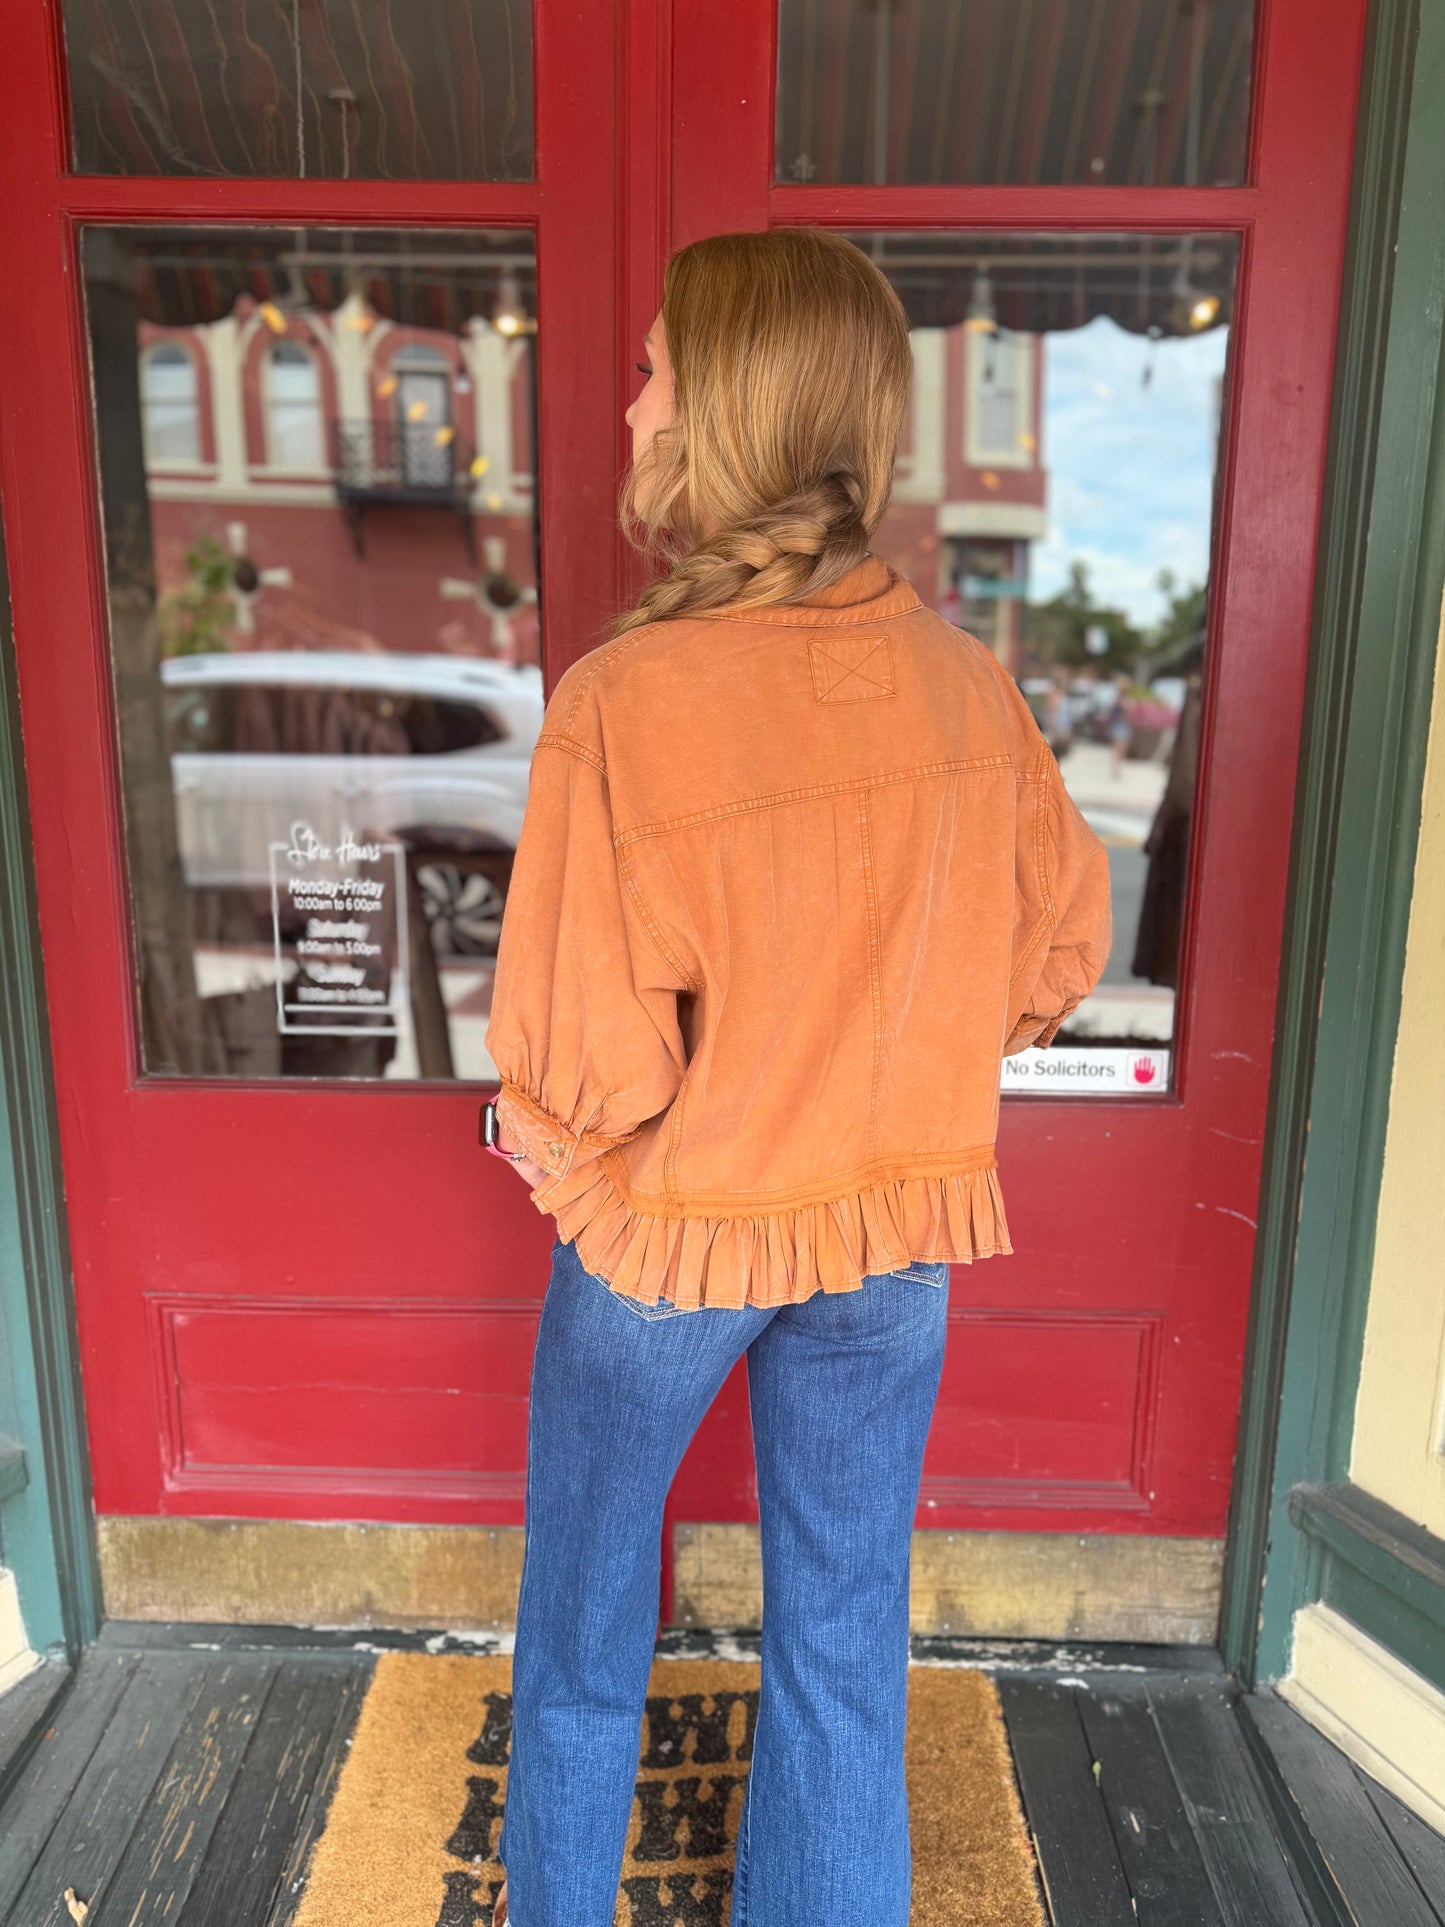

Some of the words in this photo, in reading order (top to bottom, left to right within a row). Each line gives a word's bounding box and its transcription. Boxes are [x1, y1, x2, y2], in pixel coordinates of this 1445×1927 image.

[289, 879, 384, 899] Monday-Friday
[334, 899, 344, 911] to
[1005, 1060, 1029, 1076] No
[1034, 1060, 1116, 1077] Solicitors
